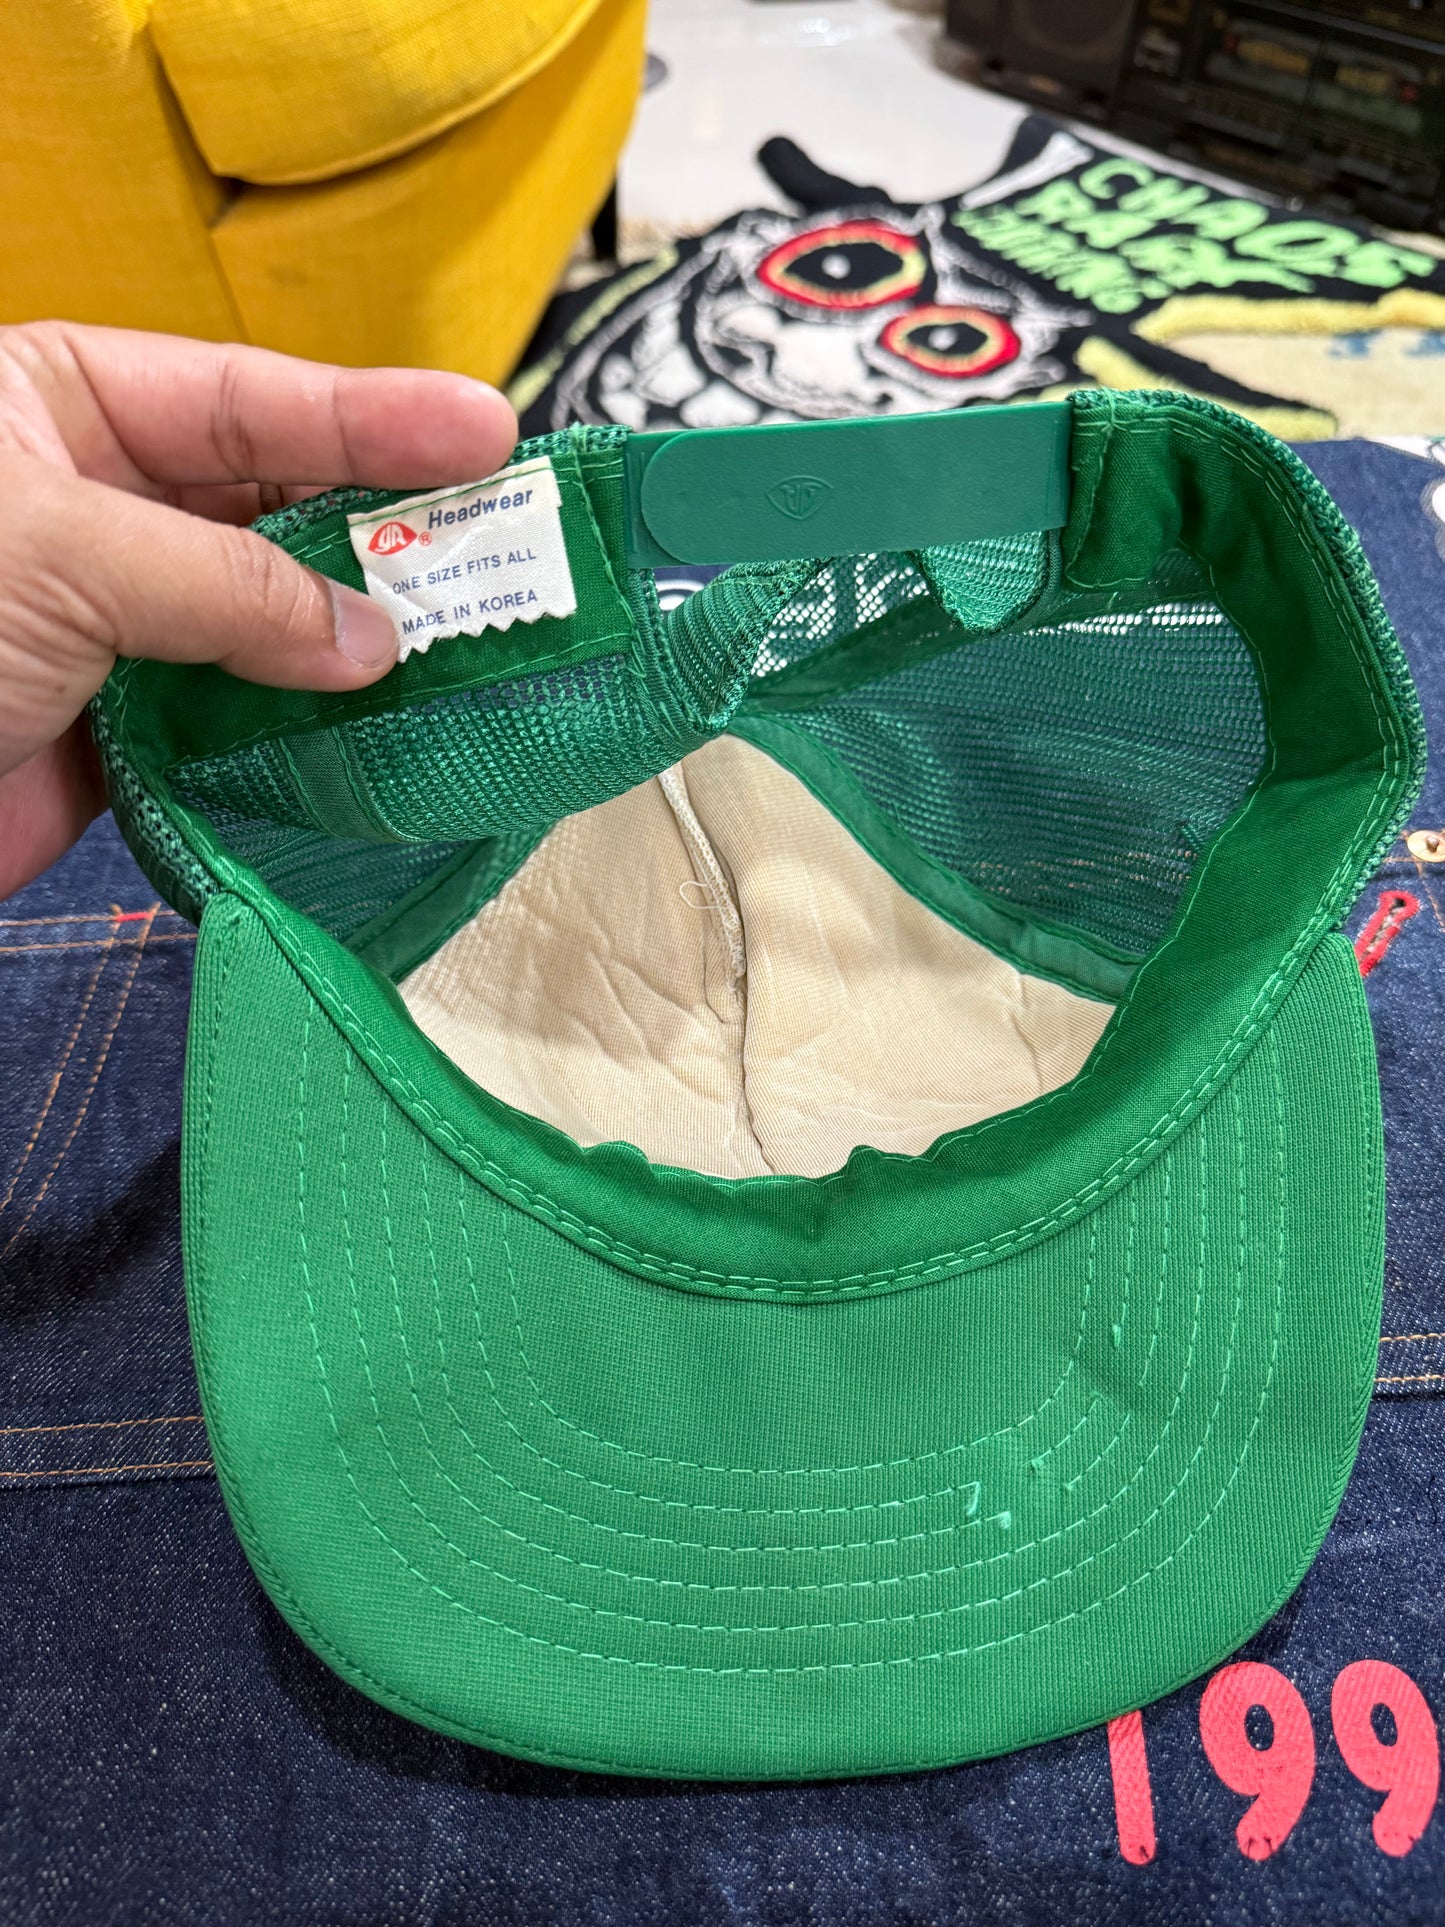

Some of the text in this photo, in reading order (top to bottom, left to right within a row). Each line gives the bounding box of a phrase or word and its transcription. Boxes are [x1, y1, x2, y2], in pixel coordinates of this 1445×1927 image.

[428, 489, 533, 529] Headwear
[392, 547, 537, 595] ONE SIZE FITS ALL
[402, 589, 538, 635] MADE IN KOREA
